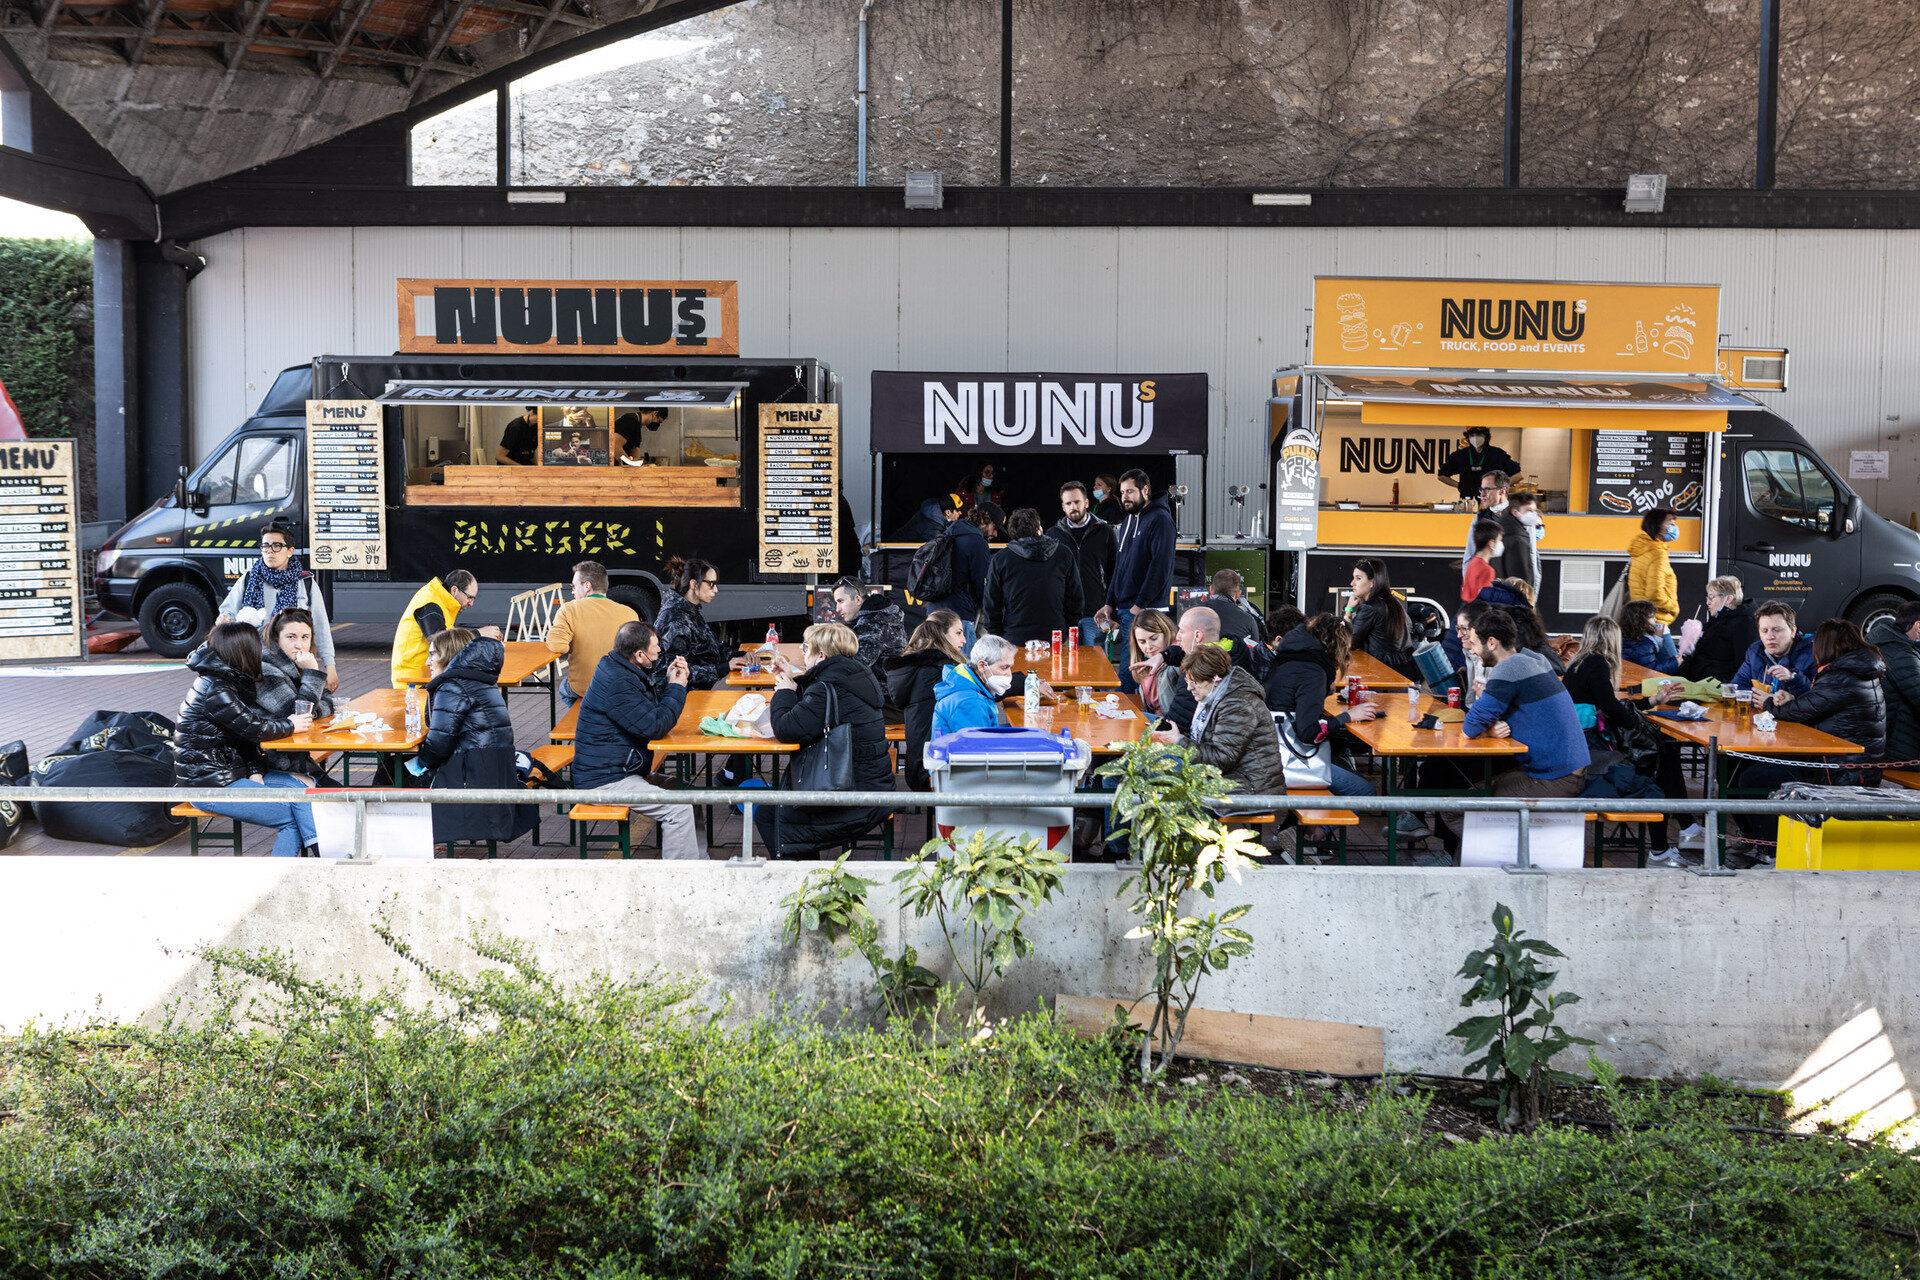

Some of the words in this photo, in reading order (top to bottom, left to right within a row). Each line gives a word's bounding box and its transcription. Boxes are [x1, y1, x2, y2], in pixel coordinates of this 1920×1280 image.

[1440, 340, 1481, 352] TRUCK,
[1483, 342, 1517, 352] FOOD
[1519, 342, 1540, 352] and
[1543, 343, 1586, 353] EVENTS
[1282, 444, 1317, 462] PULLED
